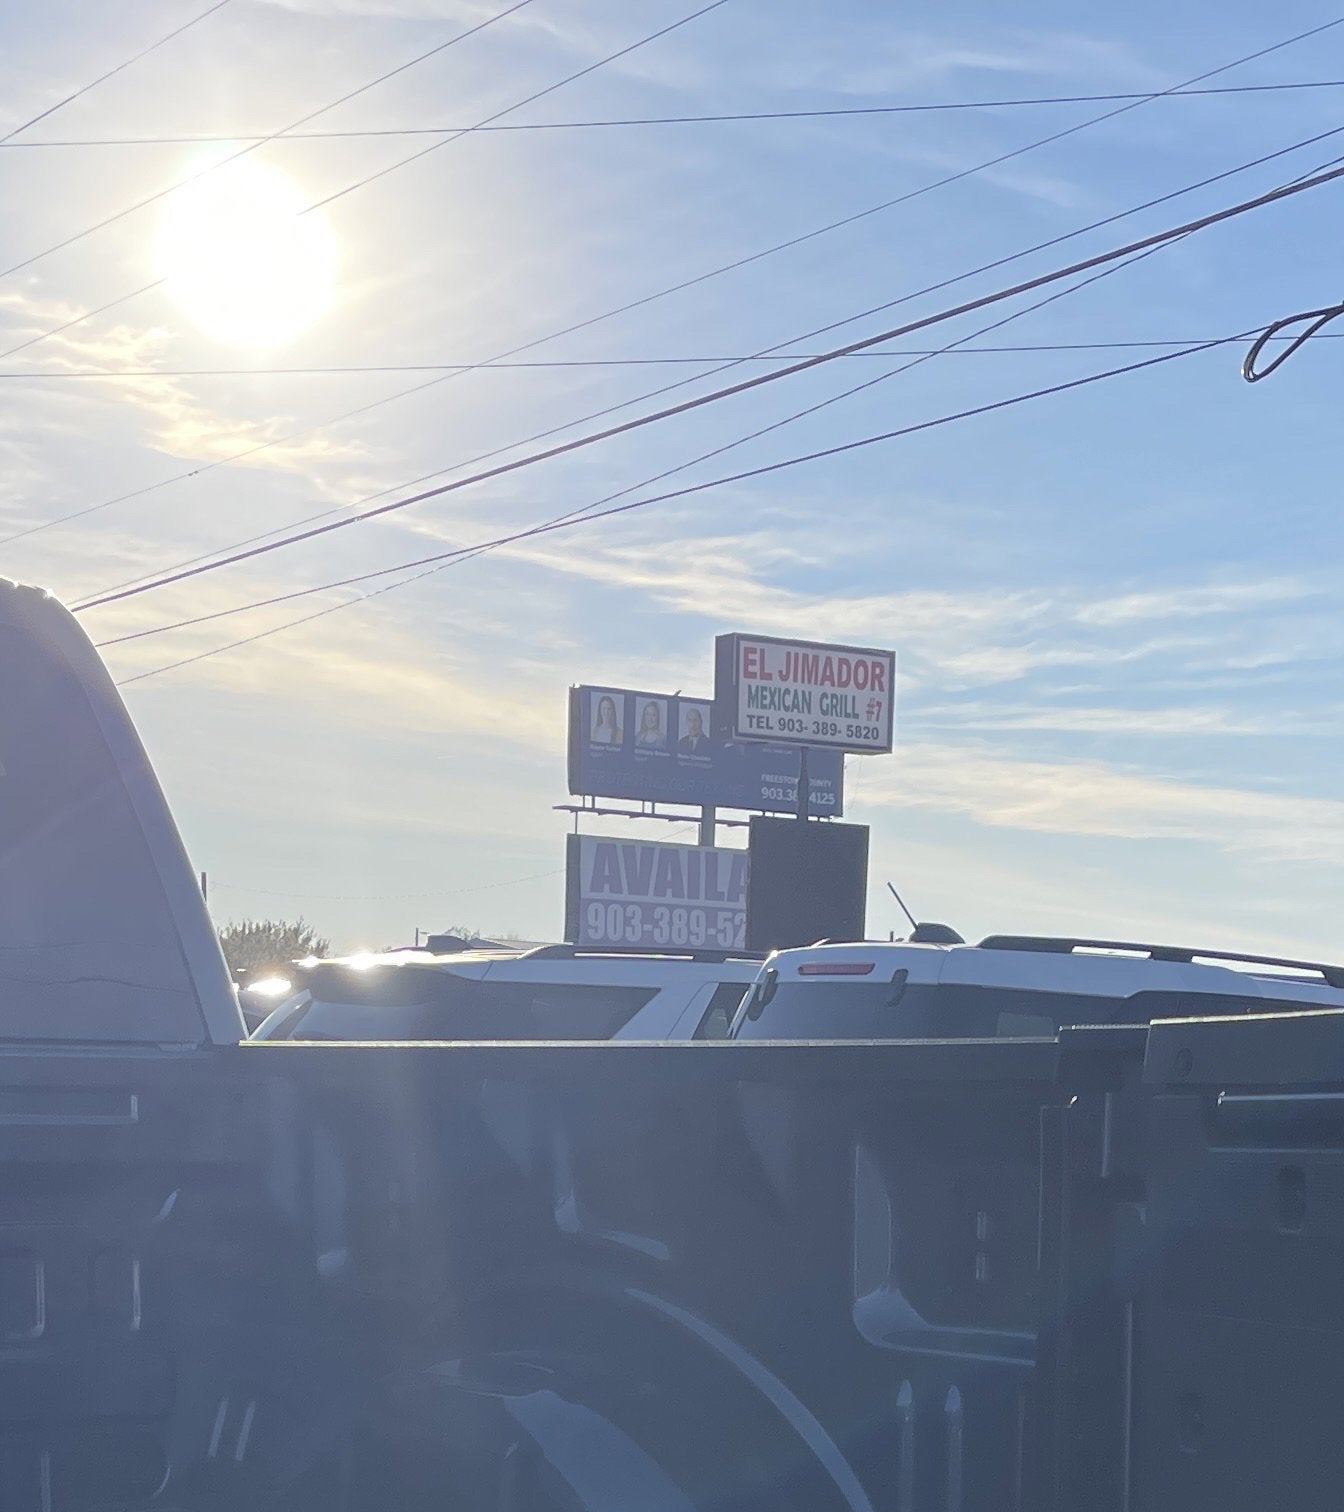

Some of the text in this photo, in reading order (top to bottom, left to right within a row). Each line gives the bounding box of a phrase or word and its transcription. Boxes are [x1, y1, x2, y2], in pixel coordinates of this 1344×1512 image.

[743, 646, 886, 693] EL JIMADOR
[747, 684, 883, 722] MEXICAN GRILL #7
[746, 714, 774, 730] TEL
[846, 724, 880, 741] 5820
